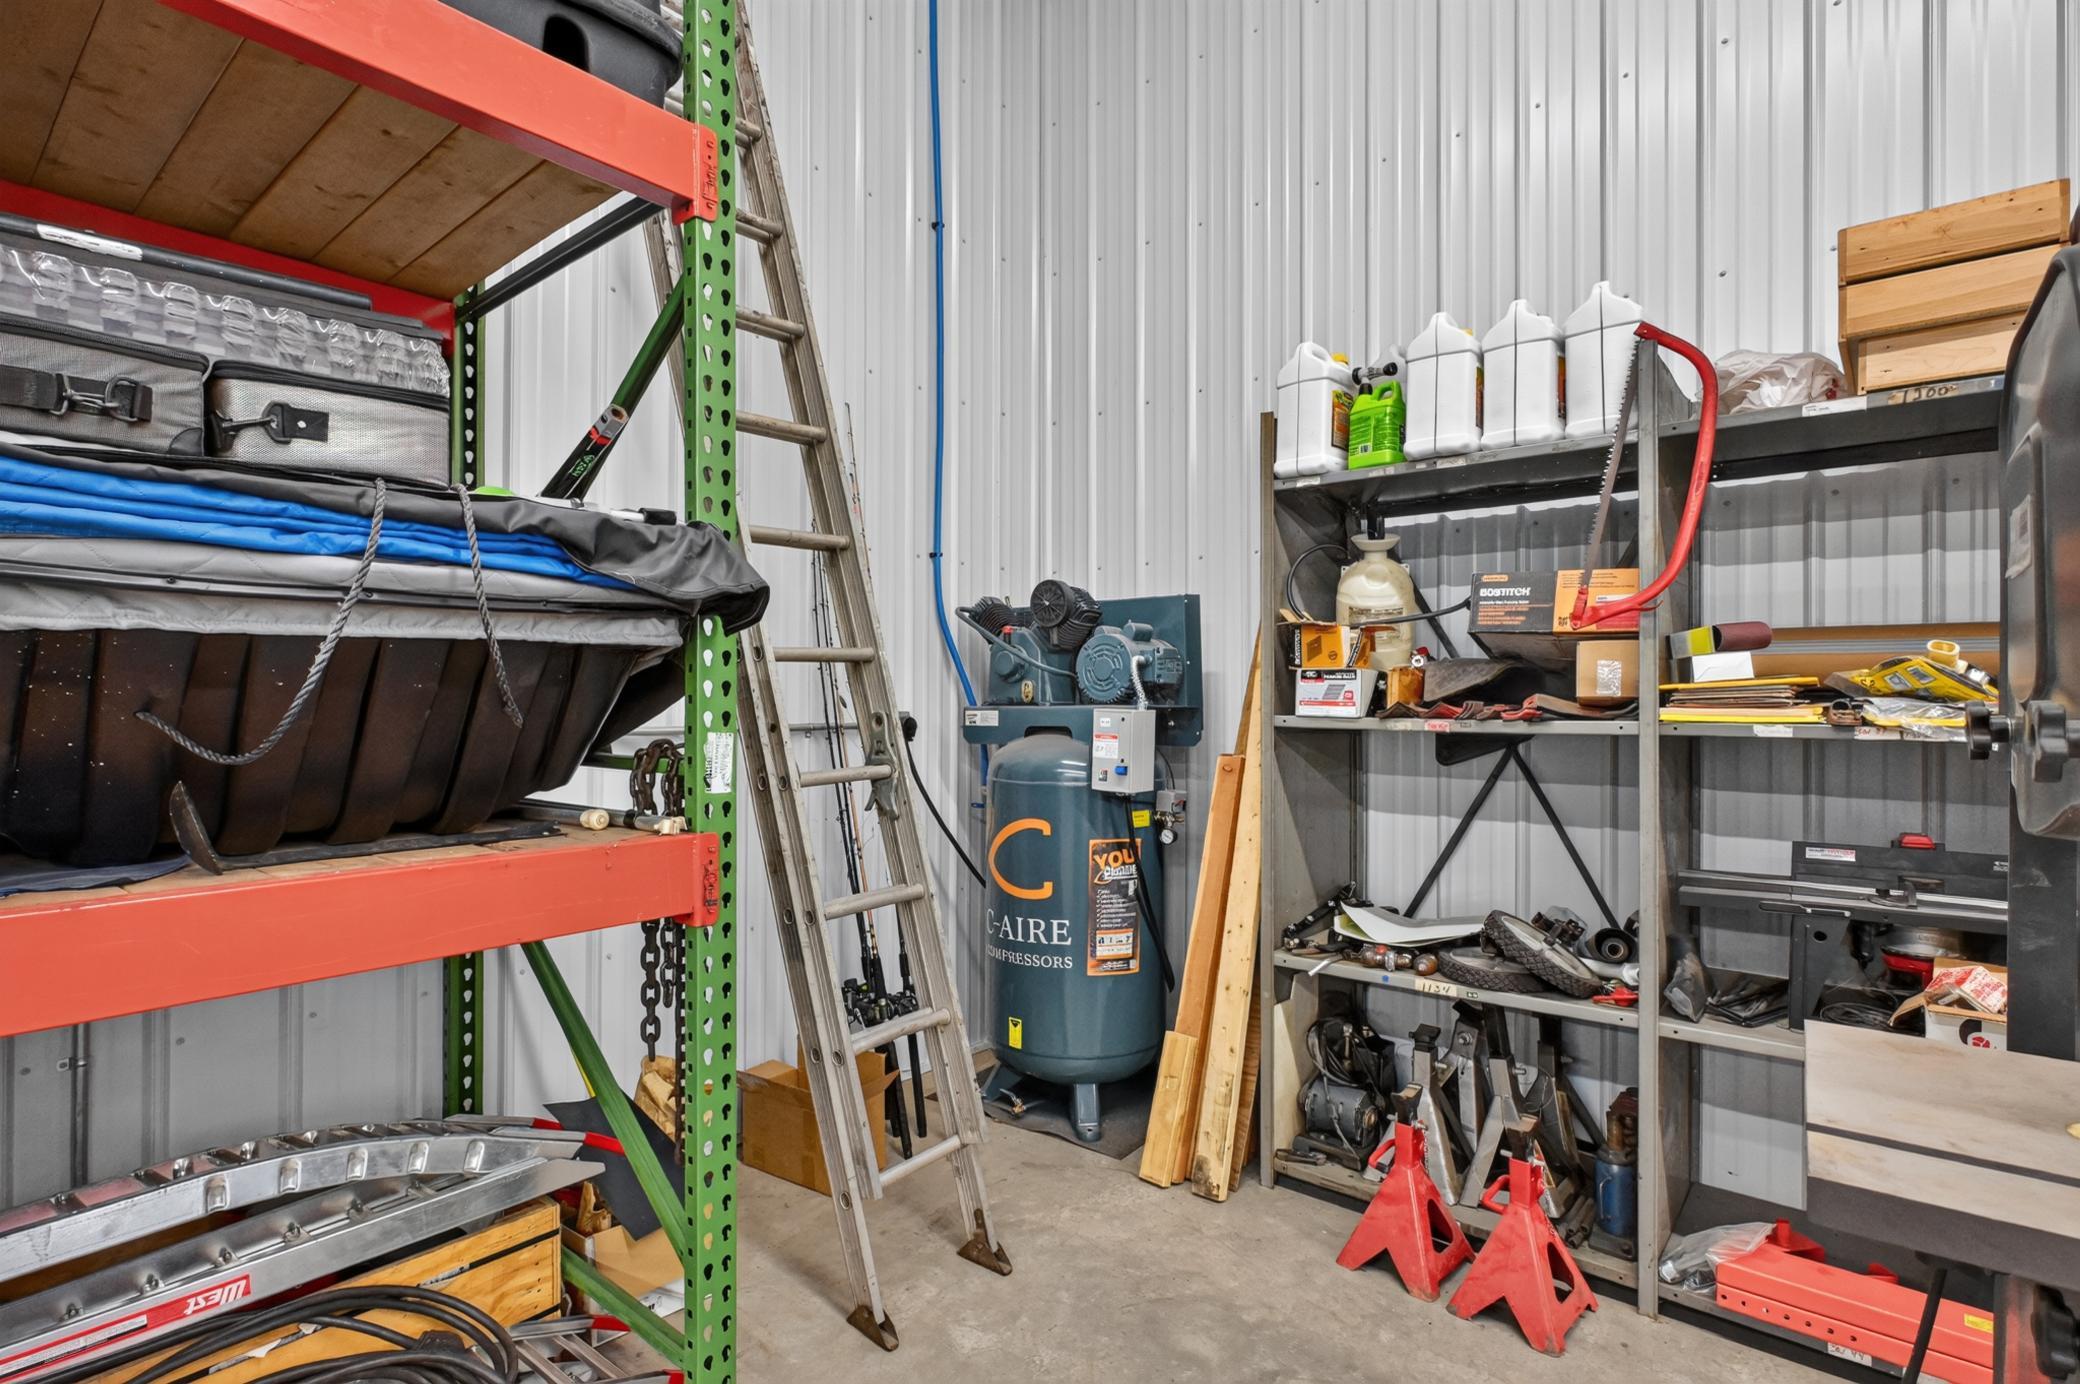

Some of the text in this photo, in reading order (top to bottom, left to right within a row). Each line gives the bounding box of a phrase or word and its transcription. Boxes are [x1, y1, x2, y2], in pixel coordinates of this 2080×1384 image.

[1479, 587, 1531, 597] BOSTITCH
[988, 818, 1053, 900] C
[1093, 848, 1135, 870] YOU
[986, 908, 1072, 946] C-AIRE
